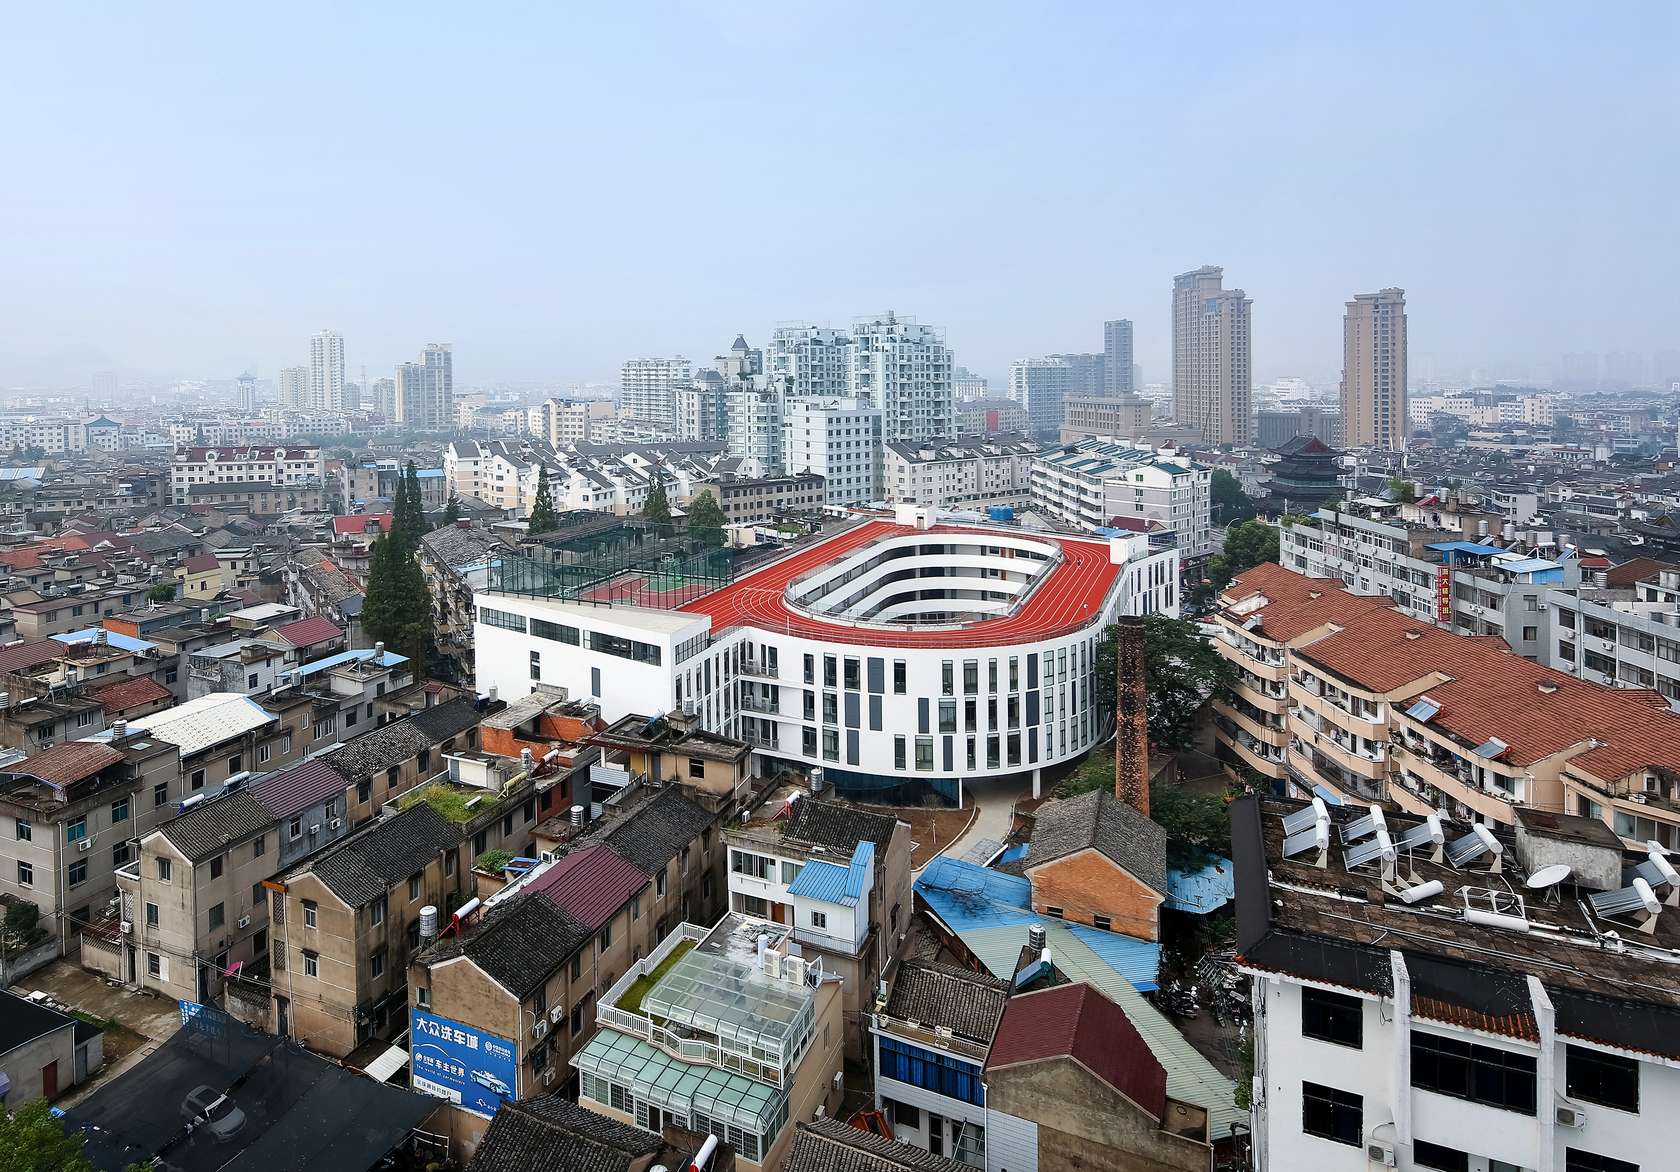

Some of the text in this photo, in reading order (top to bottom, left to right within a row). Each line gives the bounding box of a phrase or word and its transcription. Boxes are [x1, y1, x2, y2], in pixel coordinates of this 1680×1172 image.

[416, 1017, 479, 1050] 大众洗车城
[435, 1059, 465, 1077] 车主世界
